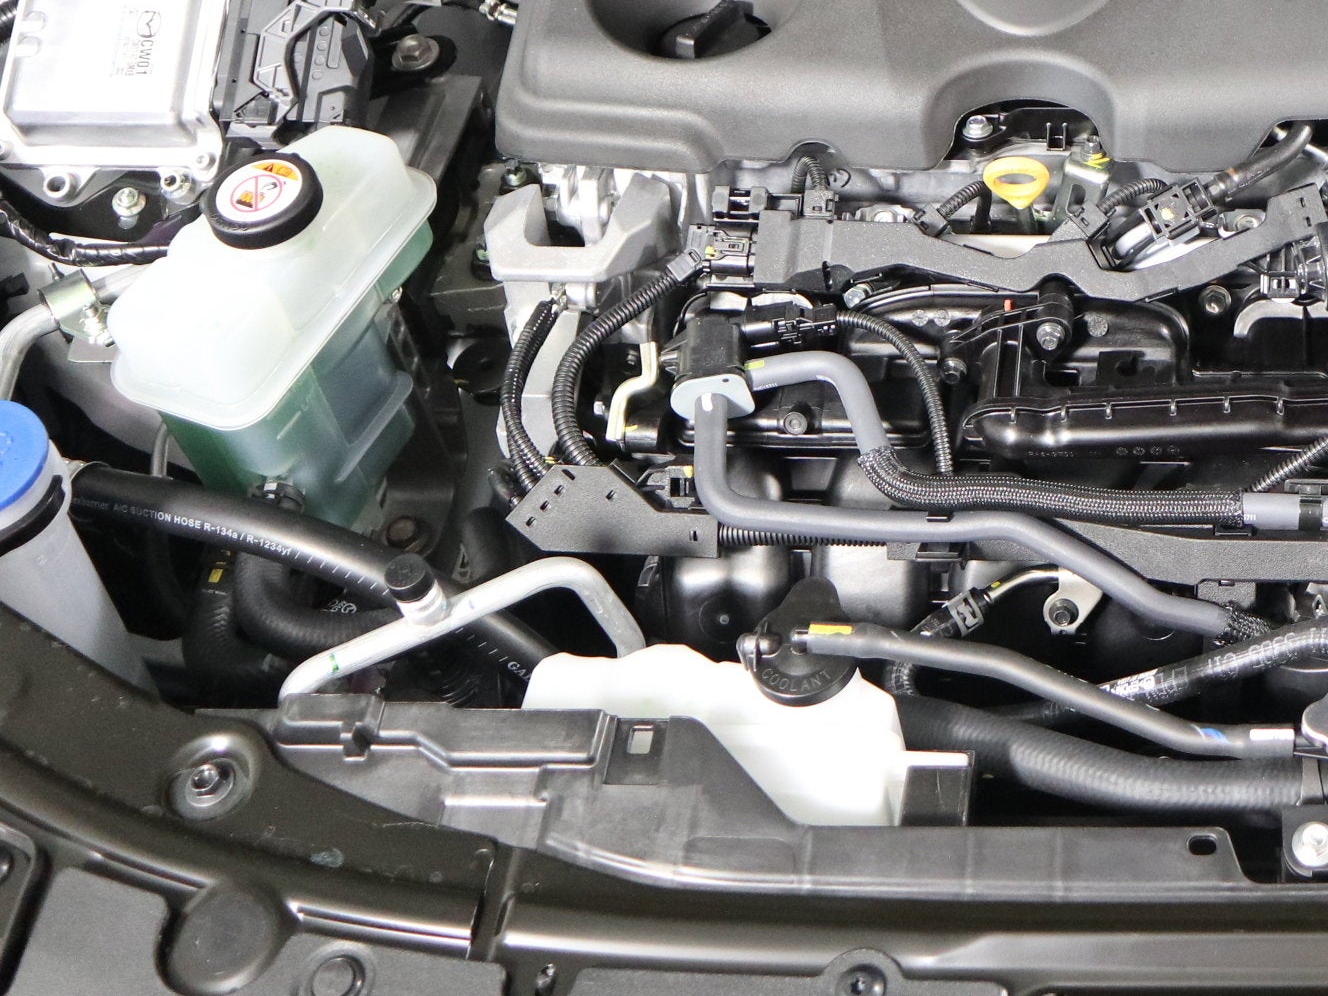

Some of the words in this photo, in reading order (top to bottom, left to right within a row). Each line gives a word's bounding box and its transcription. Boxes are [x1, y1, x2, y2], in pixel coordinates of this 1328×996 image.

[136, 39, 154, 74] CW01
[113, 503, 128, 513] A/C
[130, 506, 172, 522] SUCTION
[173, 514, 202, 530] HOSE
[203, 522, 238, 540] R-134a
[239, 533, 246, 542] /
[246, 534, 292, 556] R-1234yf
[761, 667, 832, 692] COOLANT
